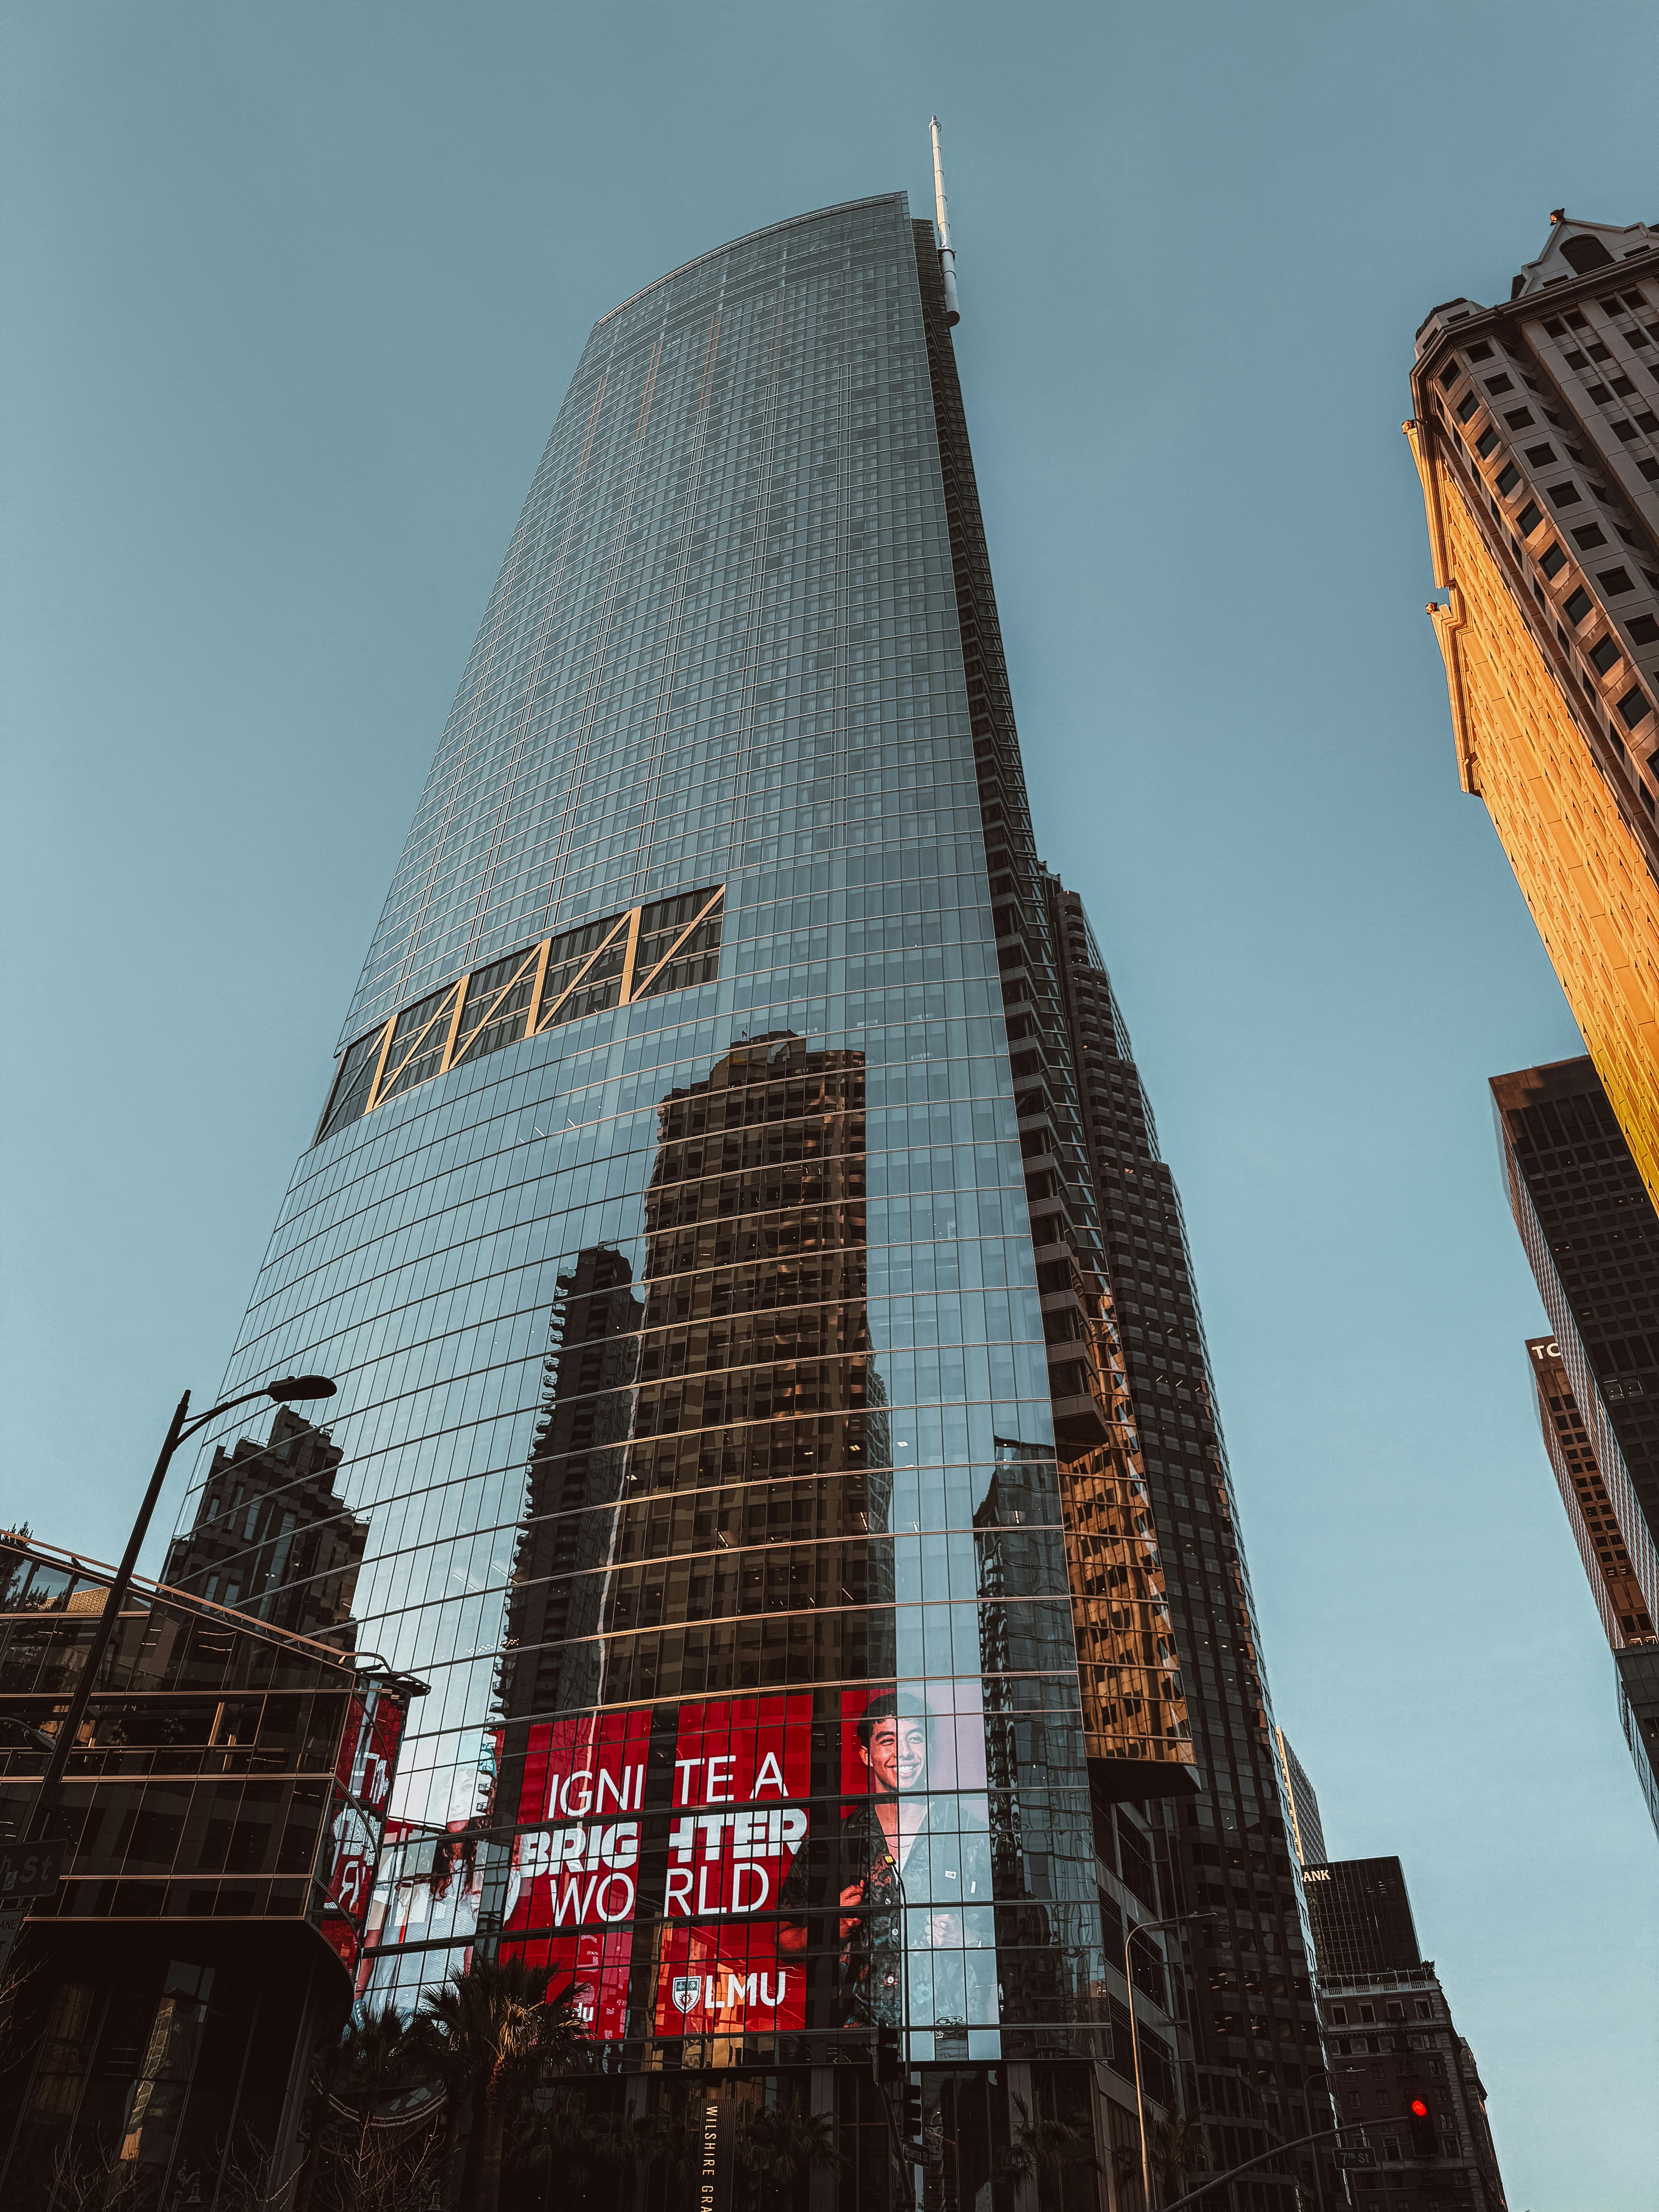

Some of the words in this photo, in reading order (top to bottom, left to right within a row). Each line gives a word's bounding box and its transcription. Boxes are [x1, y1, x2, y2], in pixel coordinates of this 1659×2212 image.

[750, 1752, 789, 1800] A
[19, 1854, 53, 1883] St
[1301, 1870, 1331, 1882] ANK
[705, 1971, 786, 2008] LMU
[702, 2106, 718, 2176] WILSHIRE
[1340, 2152, 1355, 2165] 7th
[1358, 2153, 1370, 2163] St
